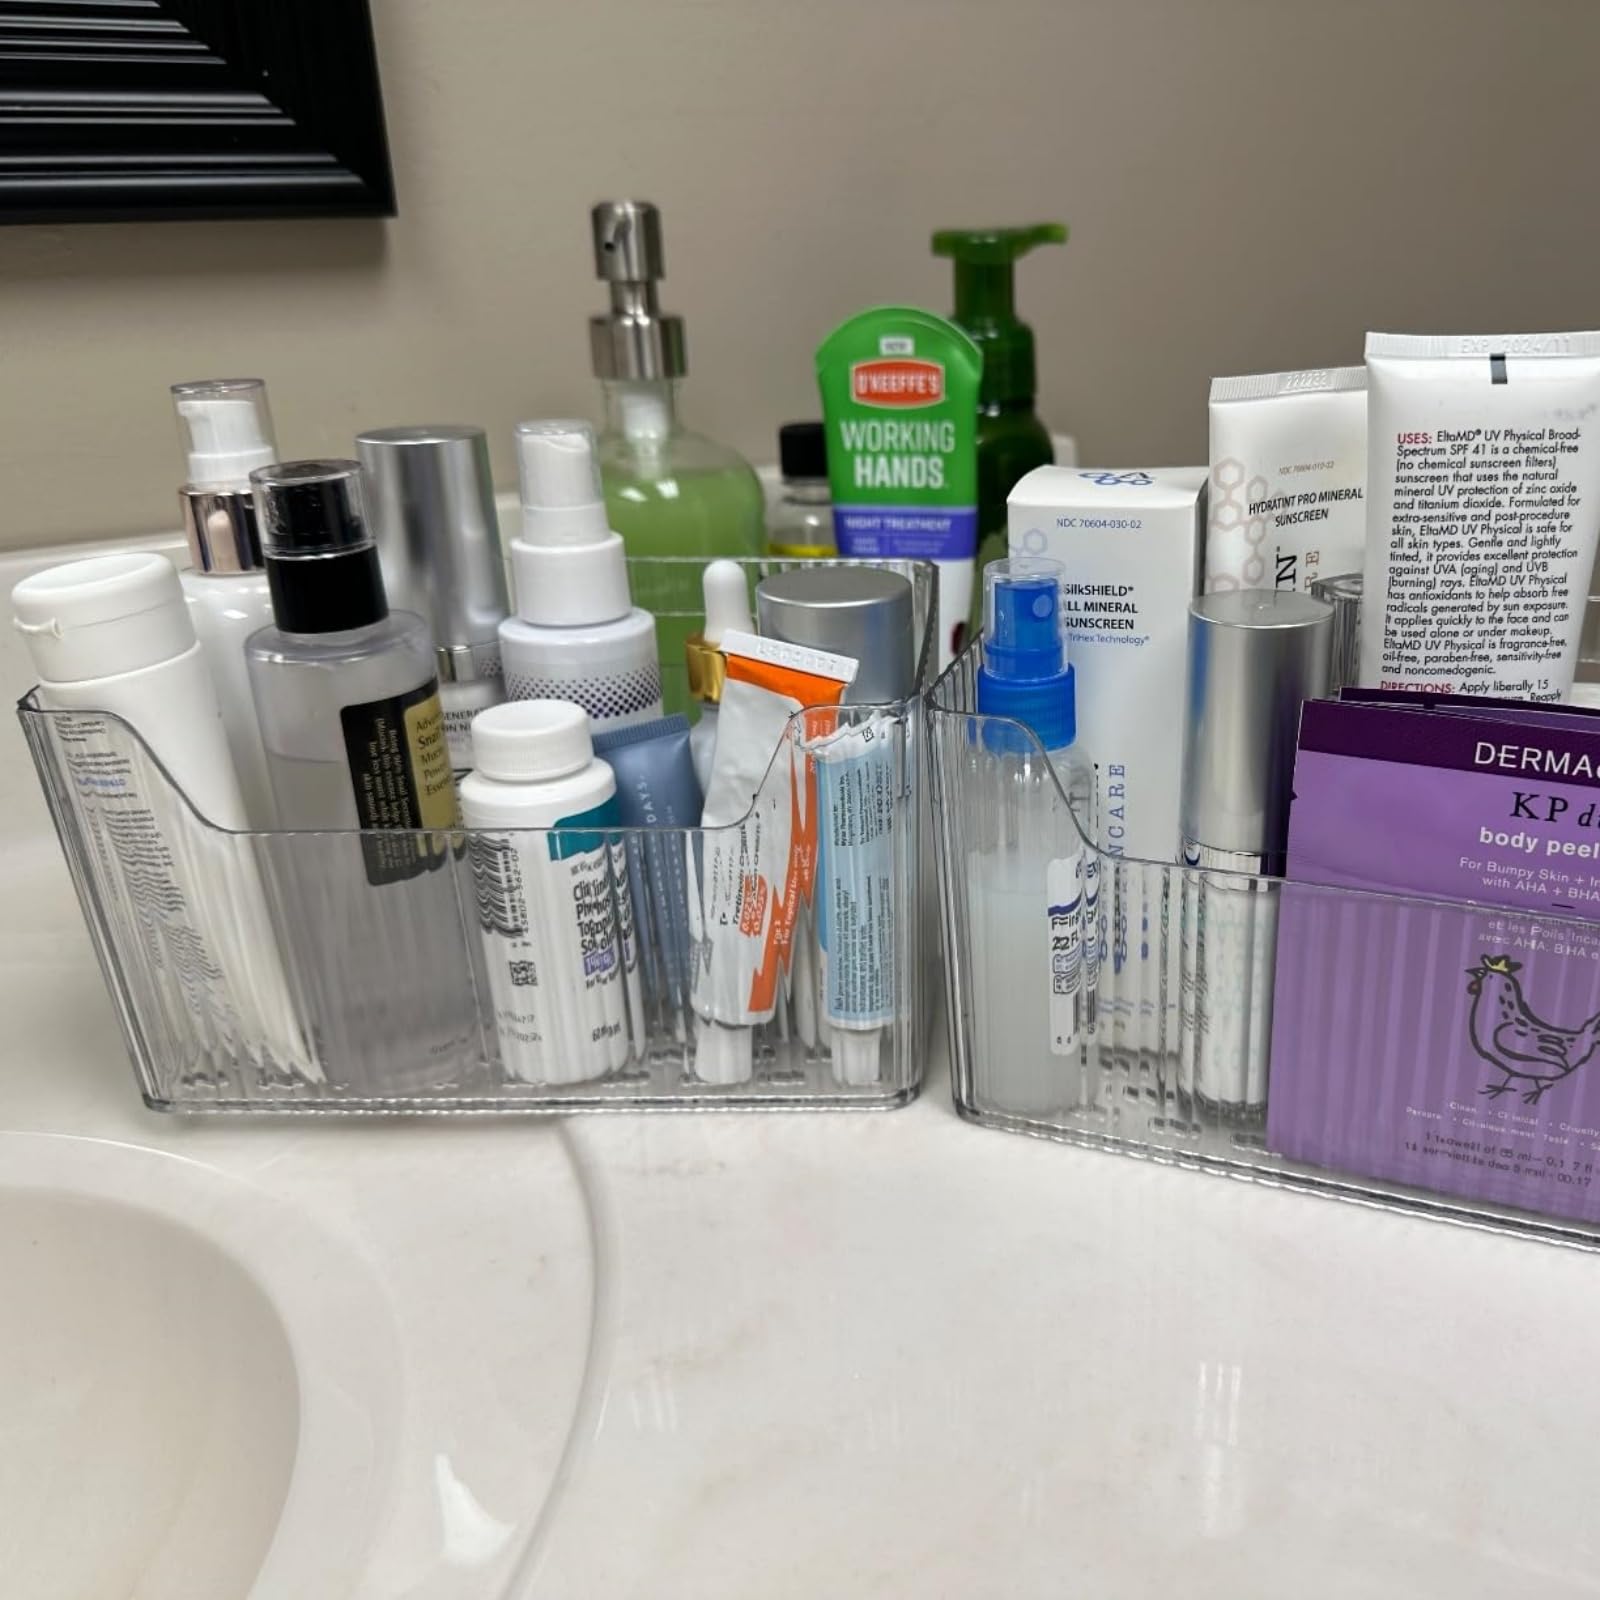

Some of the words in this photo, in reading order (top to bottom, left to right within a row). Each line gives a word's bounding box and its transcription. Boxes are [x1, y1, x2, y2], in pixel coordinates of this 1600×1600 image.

[858, 374, 941, 394] O'KEEFFE'S
[840, 420, 955, 453] WORKING
[1397, 433, 1432, 444] USES:
[1484, 431, 1501, 441] UV
[1503, 429, 1545, 443] Physical
[1549, 428, 1581, 440] Broad-
[1397, 446, 1446, 458] Spectrum
[1450, 444, 1468, 455] SPF
[1472, 444, 1485, 455] 41
[1491, 445, 1498, 455] is
[1512, 443, 1578, 454] chemical-free
[1396, 459, 1413, 472] (no
[1418, 457, 1466, 470] chemical
[1470, 458, 1521, 469] sunscreen
[1525, 455, 1556, 469] filters)
[854, 456, 945, 489] HANDS
[1395, 473, 1448, 483] sunscreen
[1453, 471, 1472, 482] that
[1477, 473, 1498, 481] uses
[1503, 471, 1518, 481] the
[1522, 469, 1558, 480] natural
[1394, 485, 1434, 496] mineral
[1438, 485, 1454, 495] UV
[1457, 484, 1508, 497] protection
[1512, 481, 1523, 494] of
[1526, 484, 1546, 494] zinc
[1550, 482, 1577, 493] oxide
[1249, 496, 1296, 515] HYDRATINT
[1297, 492, 1317, 506] PRO
[1319, 488, 1363, 502] MINERAL
[1393, 499, 1413, 510] and
[1418, 497, 1459, 509] titanium
[1463, 497, 1504, 508] dioxide.
[1509, 496, 1564, 508] Formulated
[1567, 497, 1580, 506] for
[1057, 518, 1077, 528] NDC
[1079, 519, 1142, 529] 70604-030-02
[1275, 508, 1329, 527] SUNSCREEN
[1392, 511, 1467, 523] extra-sensitive
[1471, 509, 1490, 521] and
[1495, 509, 1570, 522] post-procedure
[1392, 525, 1415, 538] skin,
[1420, 525, 1458, 536] EltaMD
[1462, 524, 1479, 535] UV
[1480, 522, 1522, 538] Physical
[1526, 524, 1532, 533] is
[1536, 522, 1556, 533] safe
[1560, 522, 1573, 532] for
[1390, 539, 1403, 549] all
[1408, 538, 1428, 549] skin
[1434, 539, 1463, 551] types.
[1468, 537, 1503, 548] Gentle
[1507, 536, 1527, 547] and
[1531, 535, 1561, 548] lightly
[1390, 552, 1421, 563] tinted,
[1426, 552, 1433, 561] it
[1436, 551, 1480, 563] provides
[1484, 550, 1528, 560] excellent
[1532, 550, 1578, 561] protection
[1389, 565, 1429, 576] against
[1433, 564, 1456, 574] UVA
[1461, 563, 1498, 576] (aging)
[1502, 562, 1522, 573] and
[1526, 562, 1548, 571] UVB
[1388, 577, 1436, 590] (burning)
[1440, 579, 1465, 590] rays.
[1470, 576, 1506, 587] EltaMD
[1510, 575, 1526, 585] UV
[1528, 573, 1567, 587] Physical
[1387, 587, 1405, 600] has
[1409, 589, 1472, 601] antioxidants
[1476, 590, 1485, 600] to
[1489, 589, 1510, 601] help
[1513, 587, 1548, 598] absorb
[1552, 587, 1568, 597] free
[1064, 603, 1081, 612] LL
[1083, 602, 1138, 614] MINERAL
[1387, 602, 1428, 613] radicals
[1431, 603, 1483, 615] generated
[1487, 602, 1500, 614] by
[1523, 601, 1568, 612] exposure.
[1394, 615, 1433, 627] applies
[1436, 614, 1472, 627] quickly
[1476, 615, 1485, 625] to
[1489, 613, 1503, 624] the
[1507, 613, 1528, 623] face
[1532, 613, 1550, 623] and
[1554, 613, 1569, 622] can
[1385, 627, 1397, 637] be
[1402, 628, 1425, 638] used
[1430, 628, 1459, 638] alone
[1463, 629, 1474, 637] or
[1477, 626, 1506, 637] under
[1511, 626, 1552, 638] makeup.
[1384, 639, 1421, 650] EltaMD
[1425, 639, 1441, 649] UV
[1444, 639, 1485, 651] Physical
[1489, 640, 1496, 649] is
[1383, 652, 1420, 664] oil-free,
[1424, 652, 1493, 665] paraben-free,
[1497, 651, 1561, 663] sensitivity-free
[1382, 664, 1400, 674] and
[1405, 665, 1496, 677] noncomedogenic.
[1459, 681, 1489, 694] Apply
[1493, 679, 1534, 692] liberally
[1537, 679, 1548, 689] 15
[1474, 741, 1600, 778] DERMA
[1479, 827, 1539, 853] body
[1547, 839, 1600, 859] peel
[1459, 857, 1481, 870] For
[1487, 861, 1534, 880] Bumpy
[1539, 869, 1570, 883] Skin
[1482, 877, 1511, 889] with
[1515, 880, 1547, 894] AHA
[1568, 887, 1600, 901] BHA
